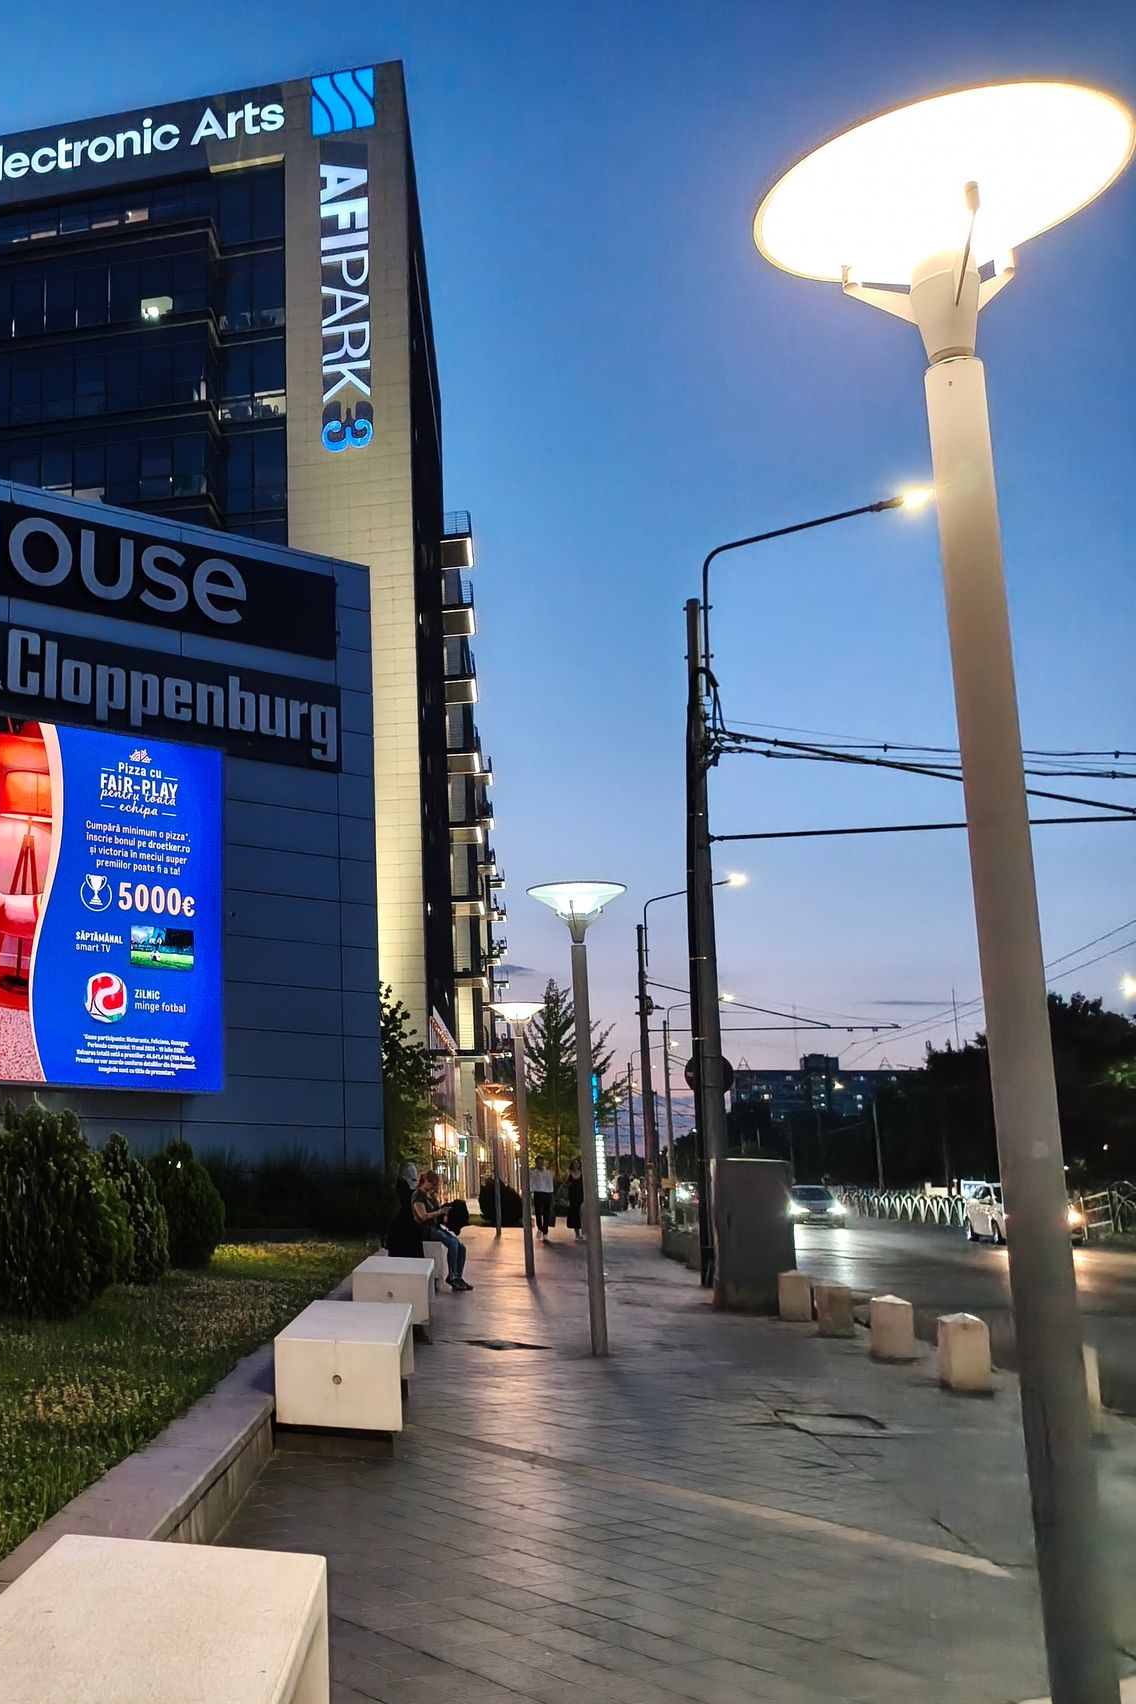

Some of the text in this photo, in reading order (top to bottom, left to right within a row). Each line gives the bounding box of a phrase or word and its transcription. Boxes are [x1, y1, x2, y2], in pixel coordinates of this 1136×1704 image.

[191, 102, 285, 146] Arts
[322, 418, 374, 453] 3
[118, 761, 162, 779] Pizza cu
[100, 788, 140, 801] pentru
[119, 801, 158, 819] echipa
[86, 820, 121, 834] Cumpără
[122, 825, 157, 838] minimum
[114, 835, 136, 847] bonul
[137, 840, 147, 849] pe
[148, 840, 191, 853] droetker.ro
[98, 846, 129, 858] victoria
[139, 851, 164, 862] meciul
[165, 856, 188, 865] super
[96, 859, 132, 869] premiilor
[133, 863, 155, 872] poate
[156, 864, 162, 873] fi
[170, 867, 181, 876] ta!
[118, 882, 195, 917] 5000€
[75, 943, 112, 953] smart TV
[134, 1001, 187, 1013] minge fotbal
